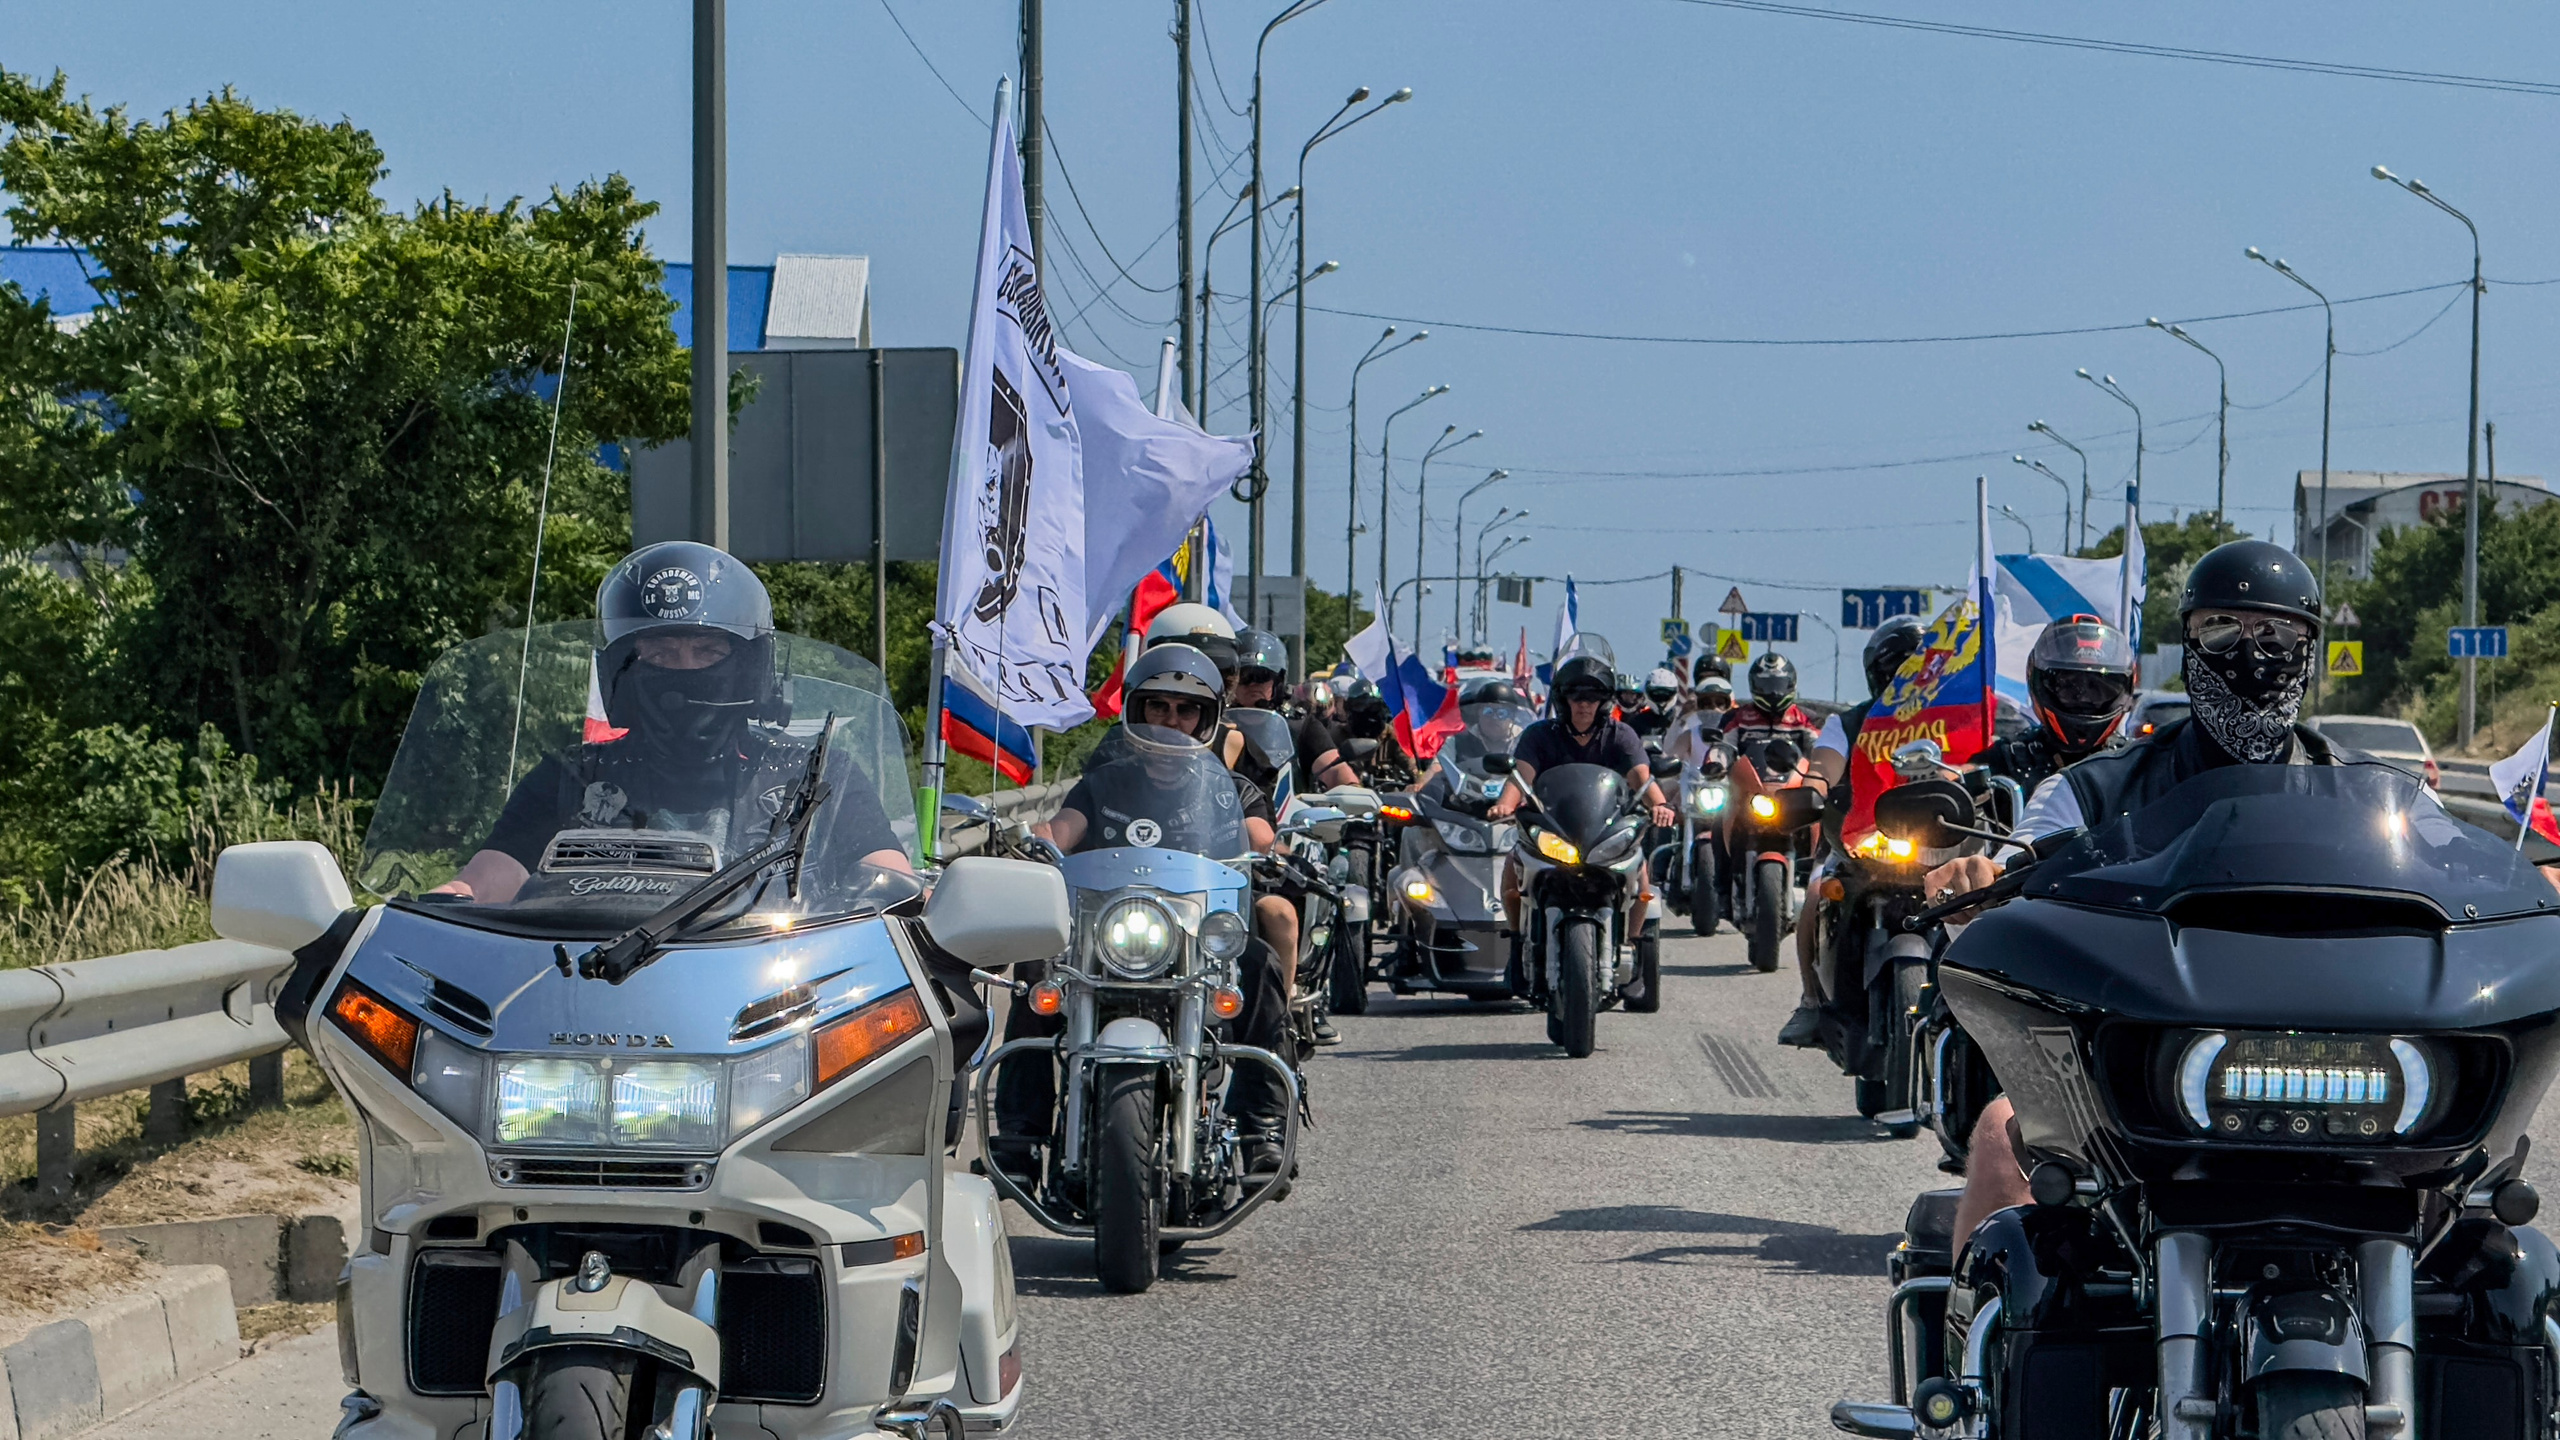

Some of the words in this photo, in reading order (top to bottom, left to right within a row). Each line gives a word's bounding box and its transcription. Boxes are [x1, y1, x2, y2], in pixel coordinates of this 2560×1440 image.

[647, 569, 698, 589] GUARDSMEN
[658, 606, 689, 619] RUSSIA
[548, 1032, 674, 1049] HONDA
